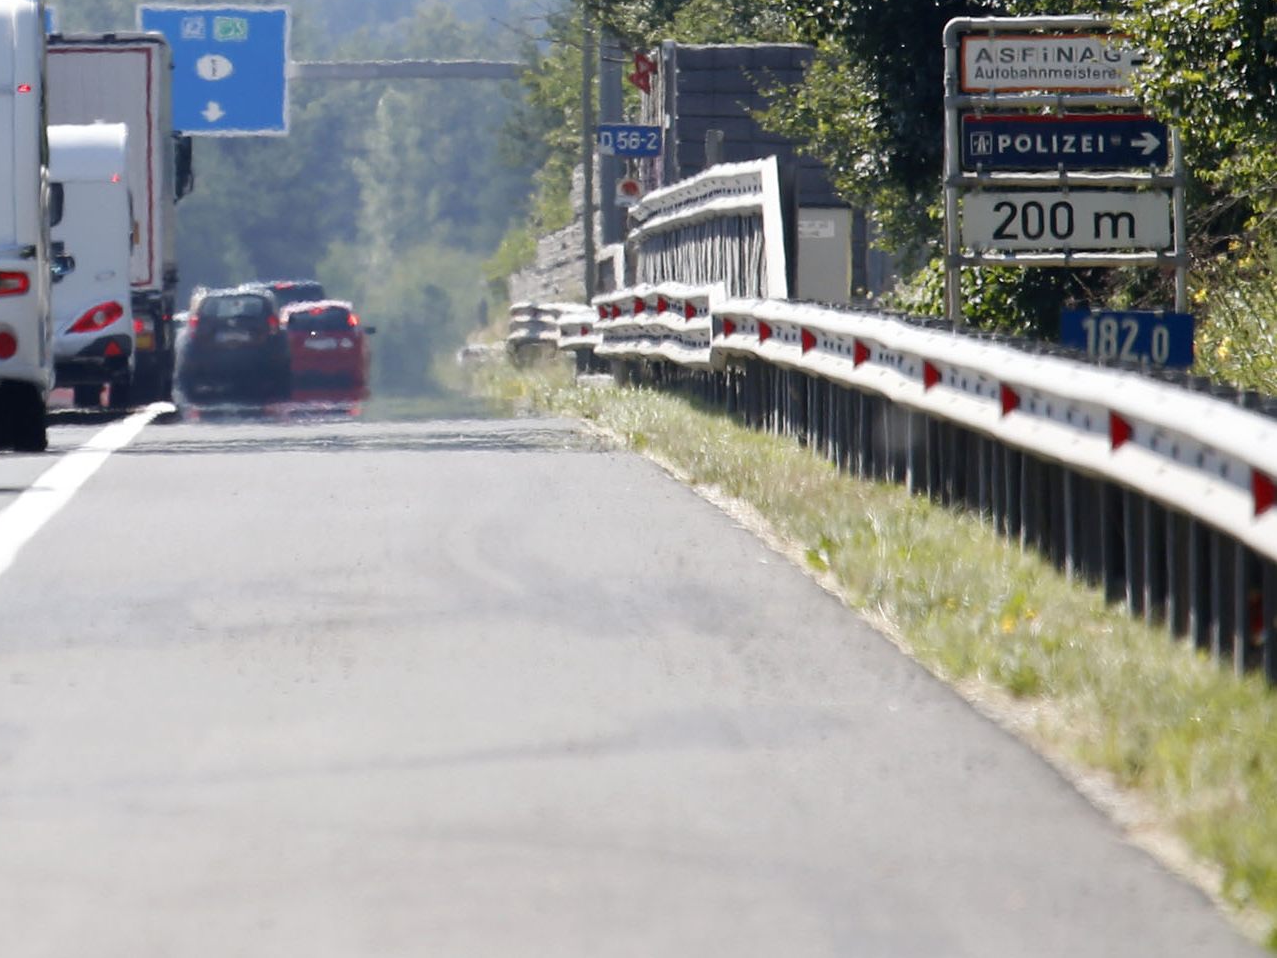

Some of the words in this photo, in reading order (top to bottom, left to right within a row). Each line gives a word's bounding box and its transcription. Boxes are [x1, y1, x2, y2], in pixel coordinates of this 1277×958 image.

[617, 131, 658, 150] 56-2
[997, 133, 1105, 154] POLIZEI
[992, 200, 1074, 241] 200
[1093, 210, 1135, 239] m
